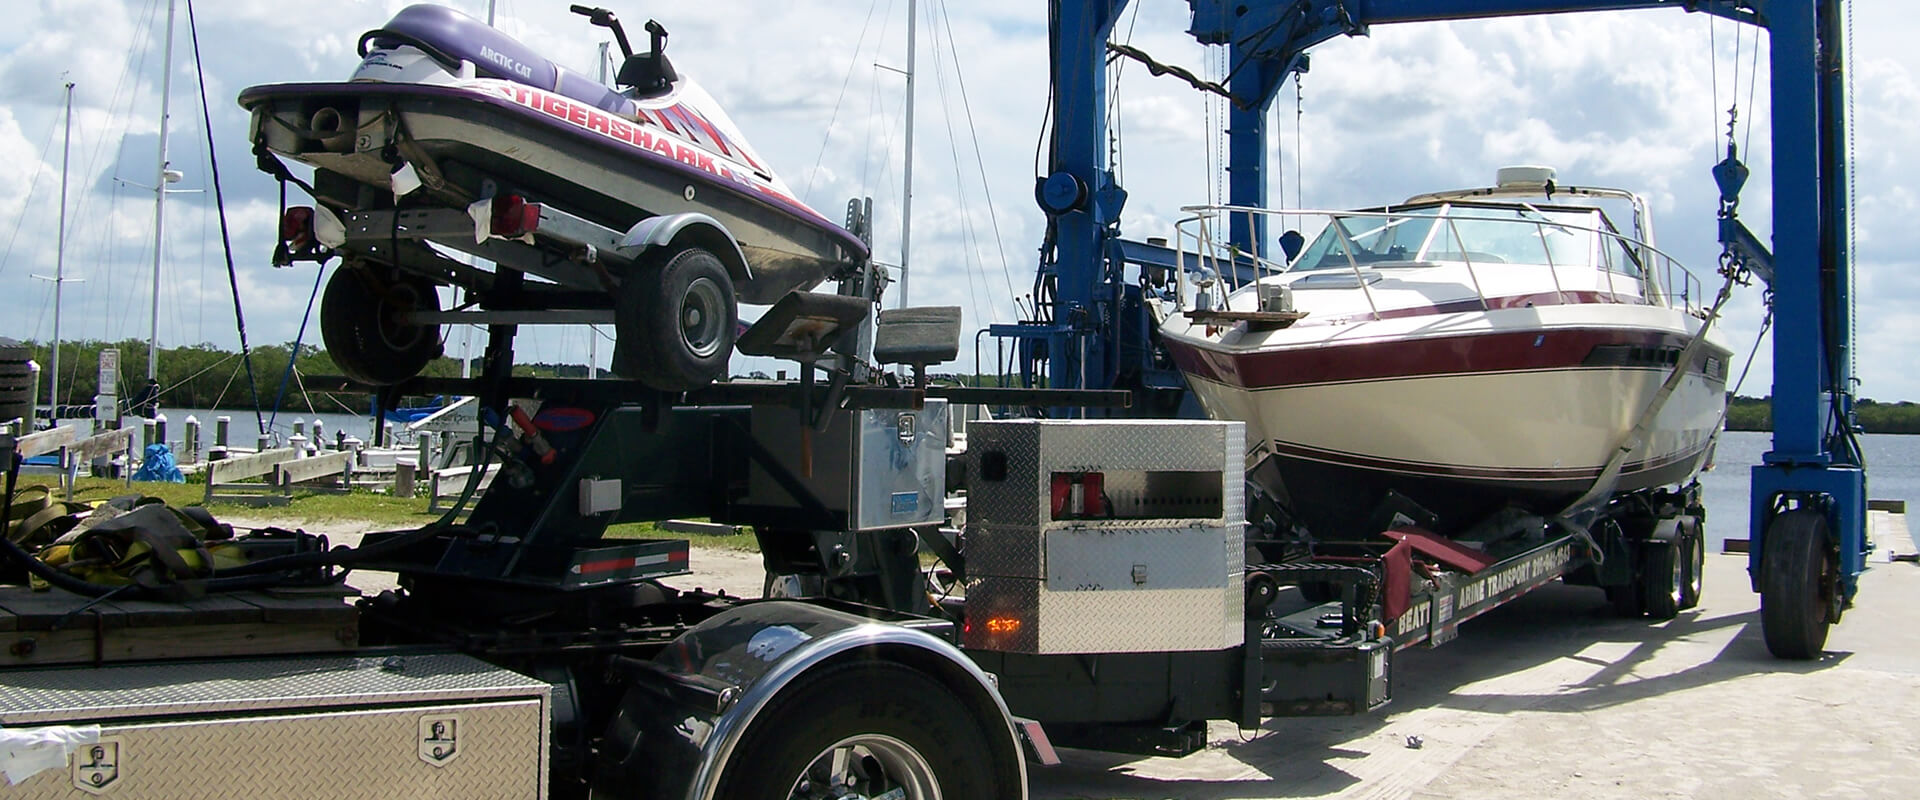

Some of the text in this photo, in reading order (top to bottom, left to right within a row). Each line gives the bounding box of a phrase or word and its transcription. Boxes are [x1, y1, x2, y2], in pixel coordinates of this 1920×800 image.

[480, 45, 532, 79] ARCTIC CAT
[510, 84, 722, 176] TIGERSHARK
[1398, 600, 1431, 636] BEATT
[1458, 579, 1486, 611] ARINE
[1487, 560, 1531, 598] TRANSPORT
